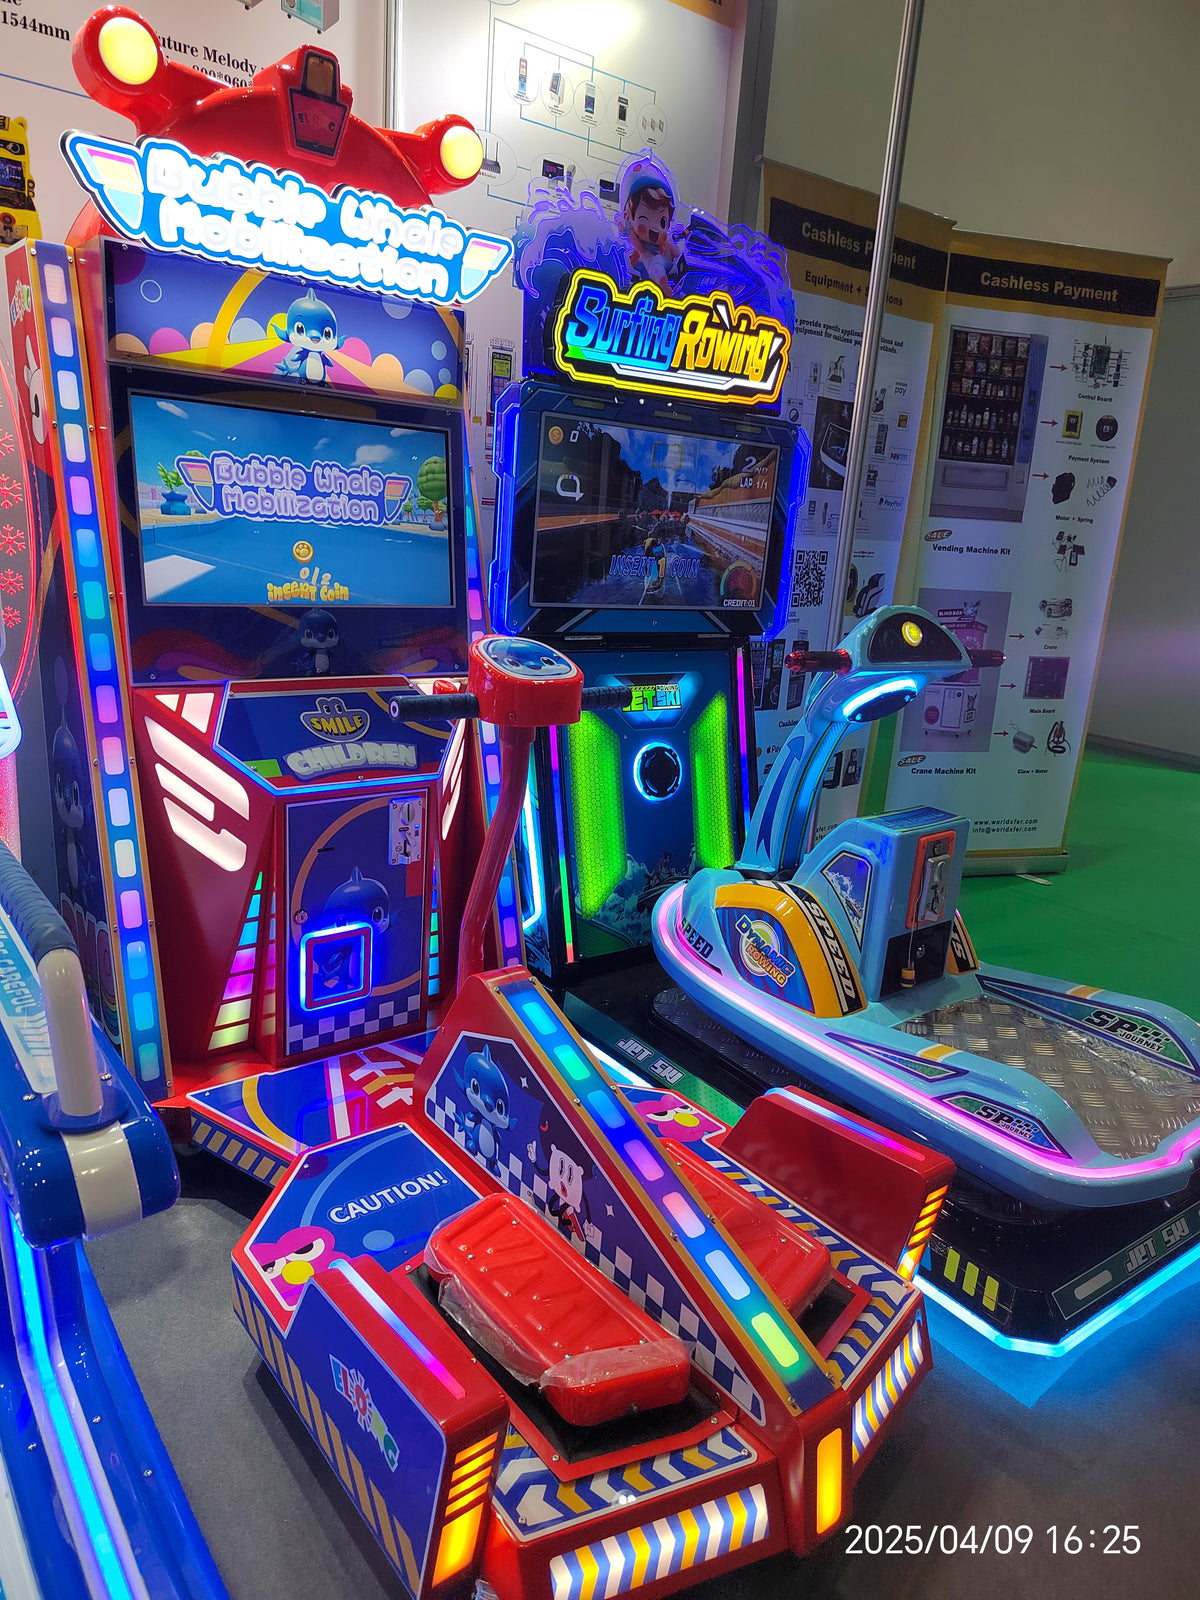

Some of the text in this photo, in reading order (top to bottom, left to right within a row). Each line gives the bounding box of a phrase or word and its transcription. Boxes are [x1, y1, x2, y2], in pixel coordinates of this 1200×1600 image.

[1, 10, 70, 41] 1544mm
[157, 34, 257, 77] uture Melody
[802, 222, 860, 253] Cashless
[805, 270, 853, 294] Equipment
[981, 272, 1119, 302] Cashless Payment
[565, 285, 774, 382] Surfing Rowing
[795, 326, 823, 337] quipment
[799, 318, 821, 328] provide
[1068, 455, 1110, 465] Payment System
[213, 455, 384, 497] Bubble Whale
[221, 486, 379, 522] Mobilization
[884, 498, 902, 508] PayPal
[1077, 516, 1094, 524] Spring
[926, 530, 950, 540] SALE
[932, 543, 1011, 555] Vending Machine Kit
[609, 554, 656, 577] INSERT
[670, 557, 701, 579] COIN
[656, 684, 679, 692] ROWING
[622, 690, 656, 712] ET
[310, 714, 364, 736] SMILE
[286, 742, 417, 775] CHILDREN
[899, 756, 924, 765] SALE
[911, 767, 977, 775] Crane Machine Kit
[972, 826, 1037, 834] info@worldxfer.com
[736, 916, 794, 974] DYNAMIC
[806, 899, 857, 1000] SPEED
[746, 944, 788, 986] ROWING
[1118, 1030, 1165, 1053] JOURNEY
[1000, 1121, 1033, 1141] JOURNEY
[328, 1170, 449, 1223] CAUTION!
